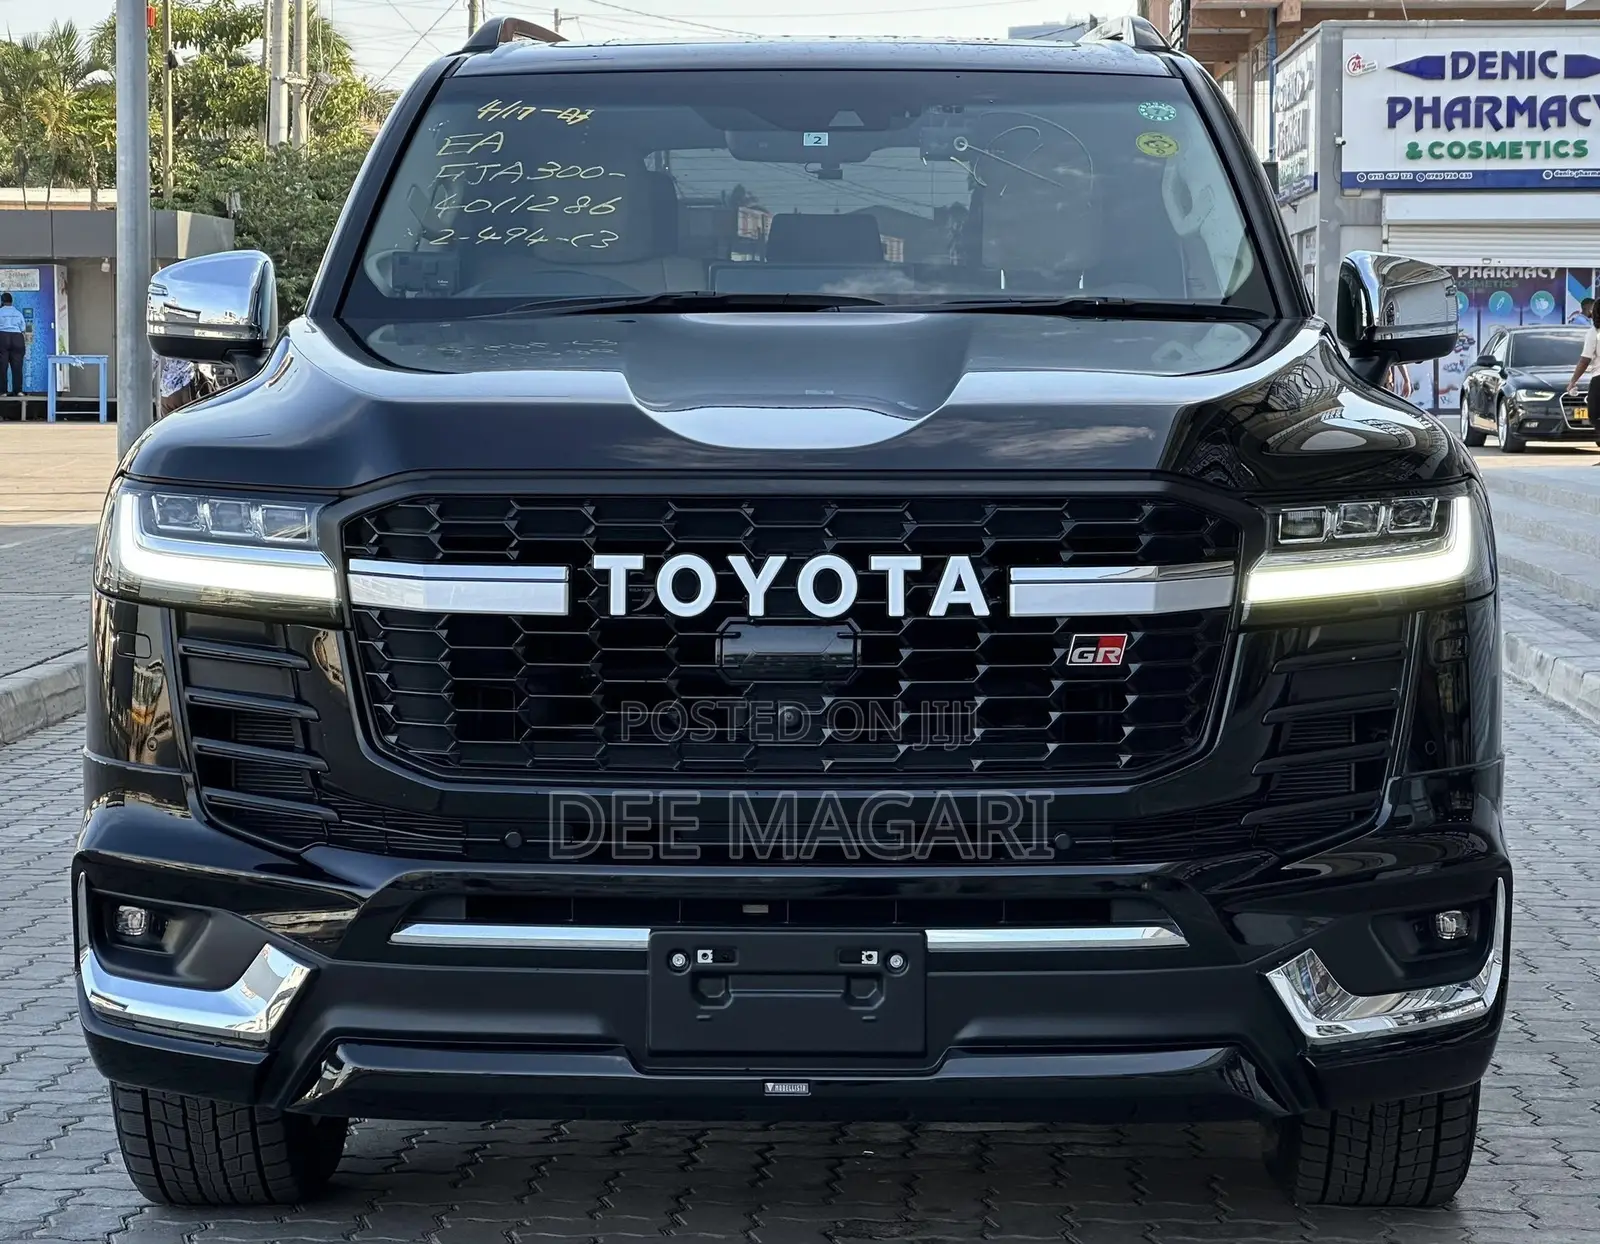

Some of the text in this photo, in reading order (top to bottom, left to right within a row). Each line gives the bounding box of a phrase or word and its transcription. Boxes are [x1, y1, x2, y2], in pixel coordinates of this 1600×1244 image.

[1451, 50, 1558, 80] DENIC
[1386, 95, 1600, 132] PHARMAC
[436, 131, 504, 156] EA
[813, 136, 822, 145] 2
[1428, 139, 1589, 160] COSMETICS
[1457, 266, 1559, 280] PHARMACY
[592, 554, 991, 618] TOYOTA
[1071, 647, 1121, 663] GR
